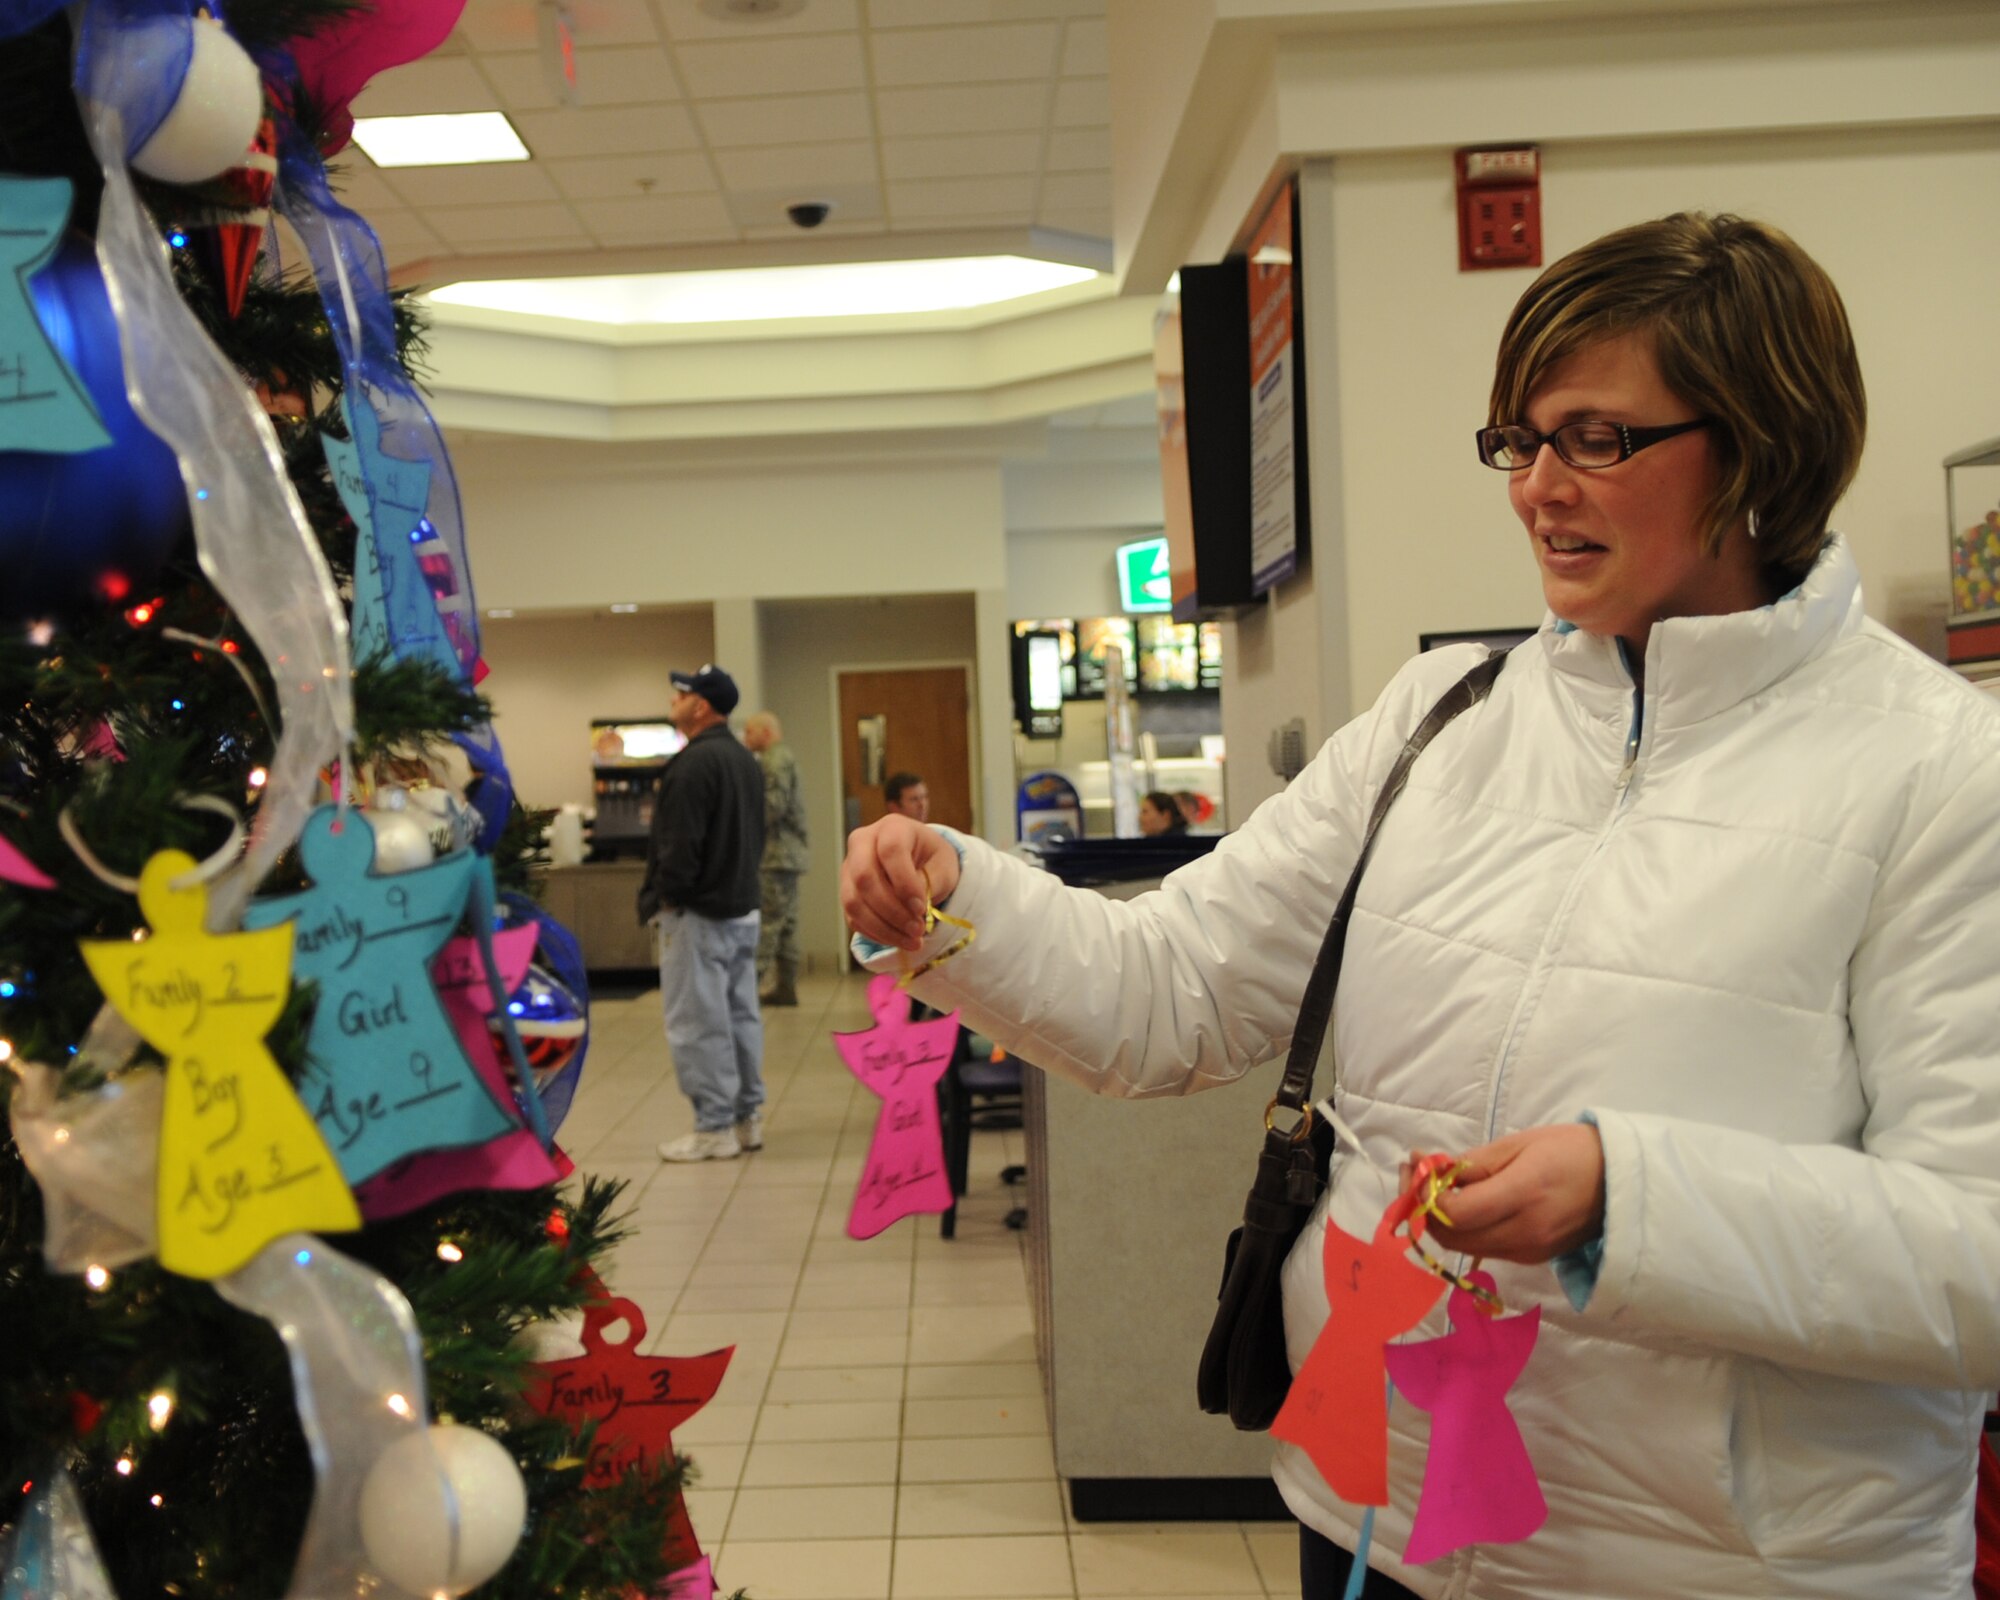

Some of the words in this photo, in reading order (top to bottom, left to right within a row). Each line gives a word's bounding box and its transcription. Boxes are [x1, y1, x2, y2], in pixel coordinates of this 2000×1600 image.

[290, 904, 364, 972] amily
[386, 886, 410, 919] 9
[125, 958, 205, 1037] Family
[222, 961, 243, 998] 2
[338, 984, 408, 1036] Girl
[183, 1057, 243, 1154] Boy
[315, 1083, 387, 1150] Age
[409, 1051, 433, 1094] 9
[176, 1160, 250, 1235] Age
[547, 1370, 624, 1425] Family
[649, 1368, 671, 1400] 3
